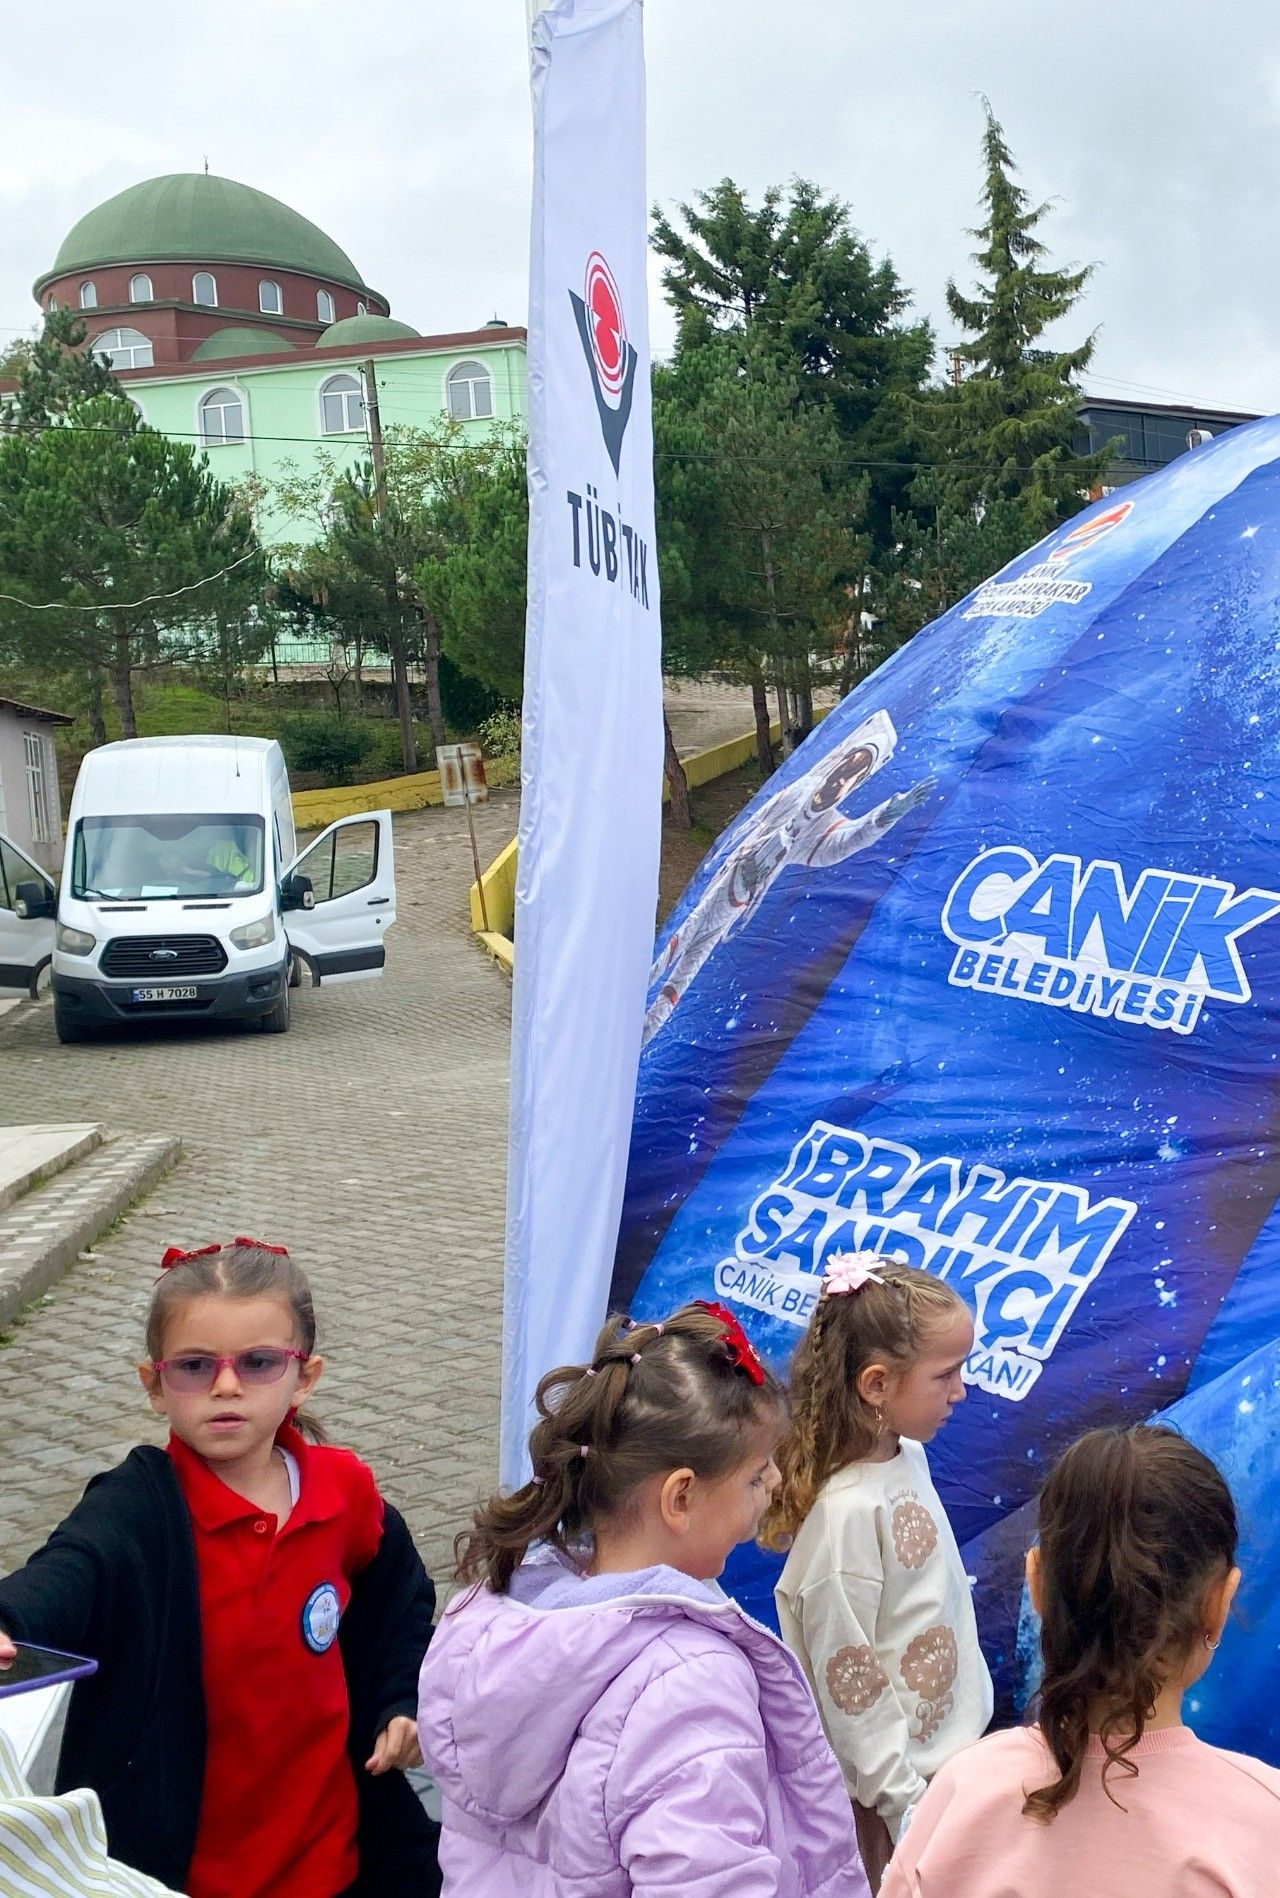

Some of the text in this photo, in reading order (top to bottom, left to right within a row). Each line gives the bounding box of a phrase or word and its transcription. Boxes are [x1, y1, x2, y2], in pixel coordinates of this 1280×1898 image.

[567, 482, 649, 611] TÜBİTAK
[1013, 582, 1089, 601] BAYRAKTAR
[139, 988, 196, 999] 55 H 7028
[953, 949, 1198, 1029] BELEDİYESİ
[778, 1128, 1129, 1277] İBRAHİM
[720, 1264, 784, 1305] CANİK
[966, 1350, 1032, 1392] KANI
